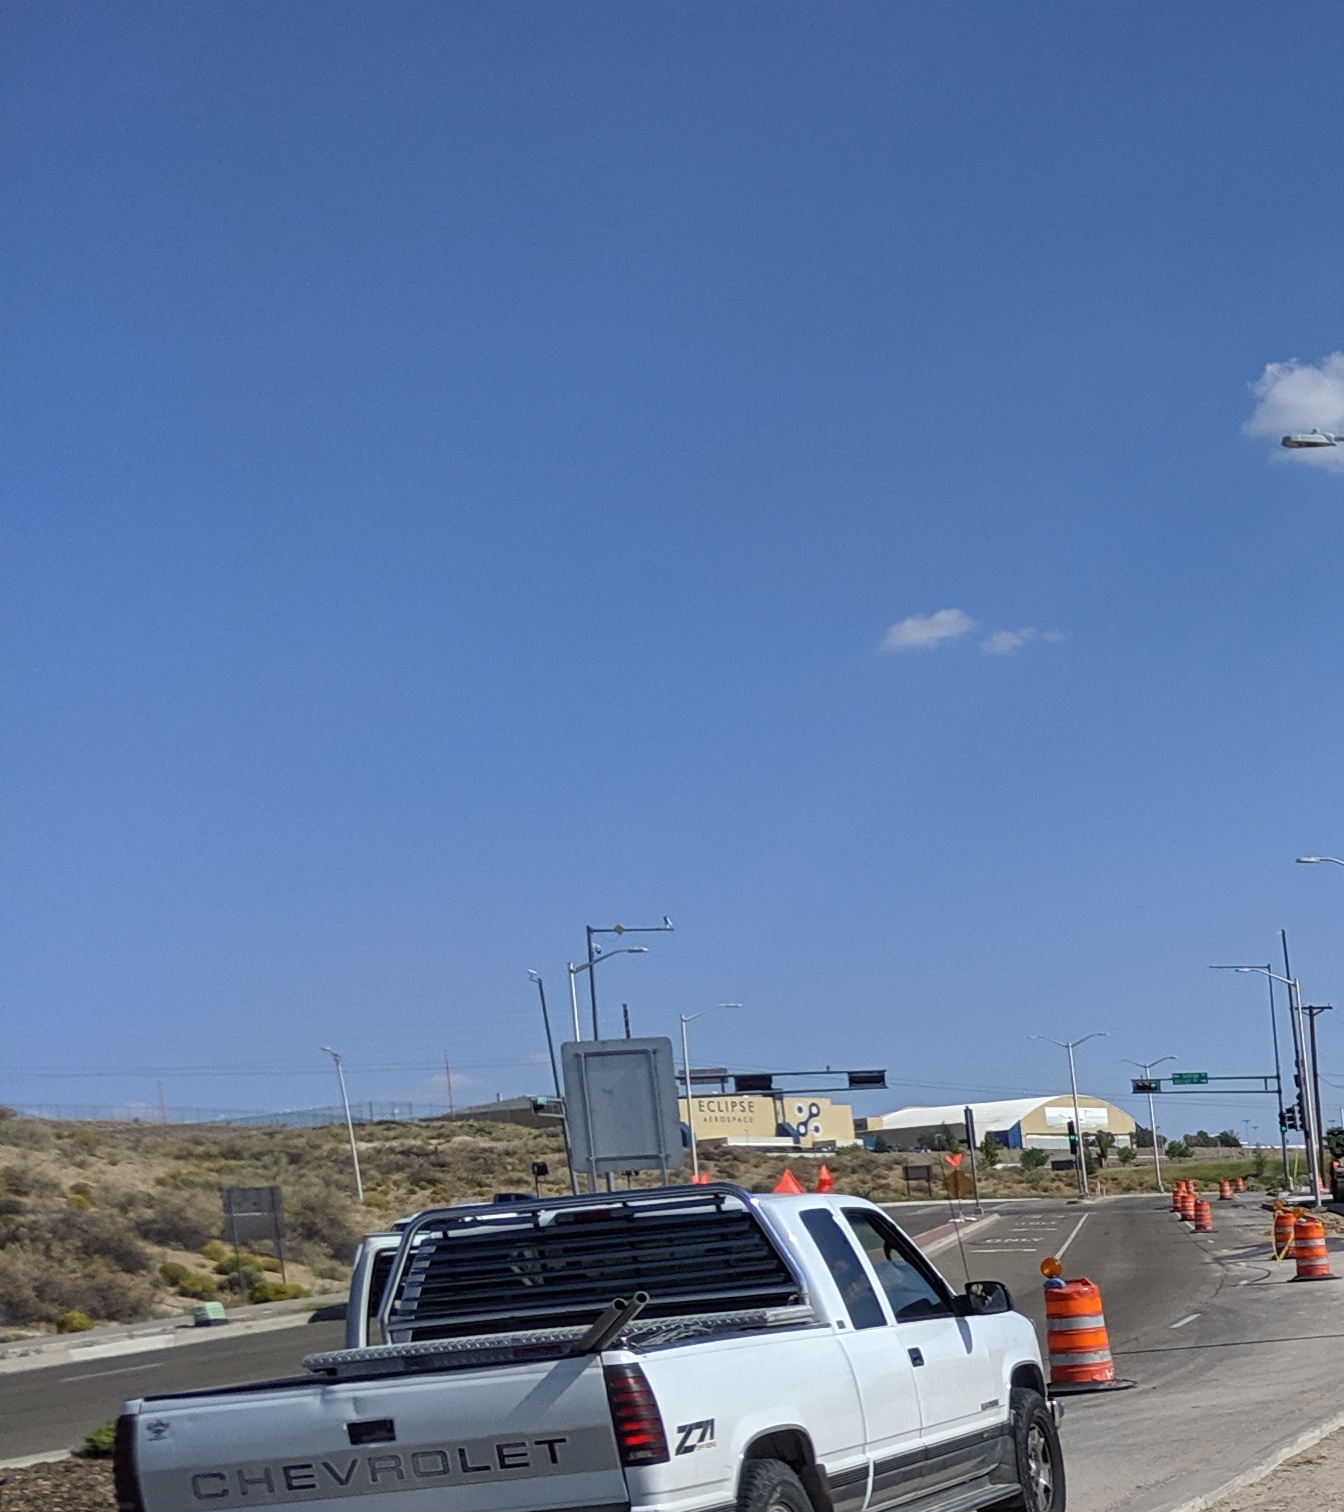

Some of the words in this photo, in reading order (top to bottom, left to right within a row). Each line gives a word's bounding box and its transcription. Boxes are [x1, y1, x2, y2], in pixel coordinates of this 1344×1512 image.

[698, 1100, 755, 1113] ECLIPSE
[703, 1116, 754, 1124] AEROSPACE
[675, 1417, 715, 1456] Z71
[190, 1437, 568, 1500] CHEVROLET
